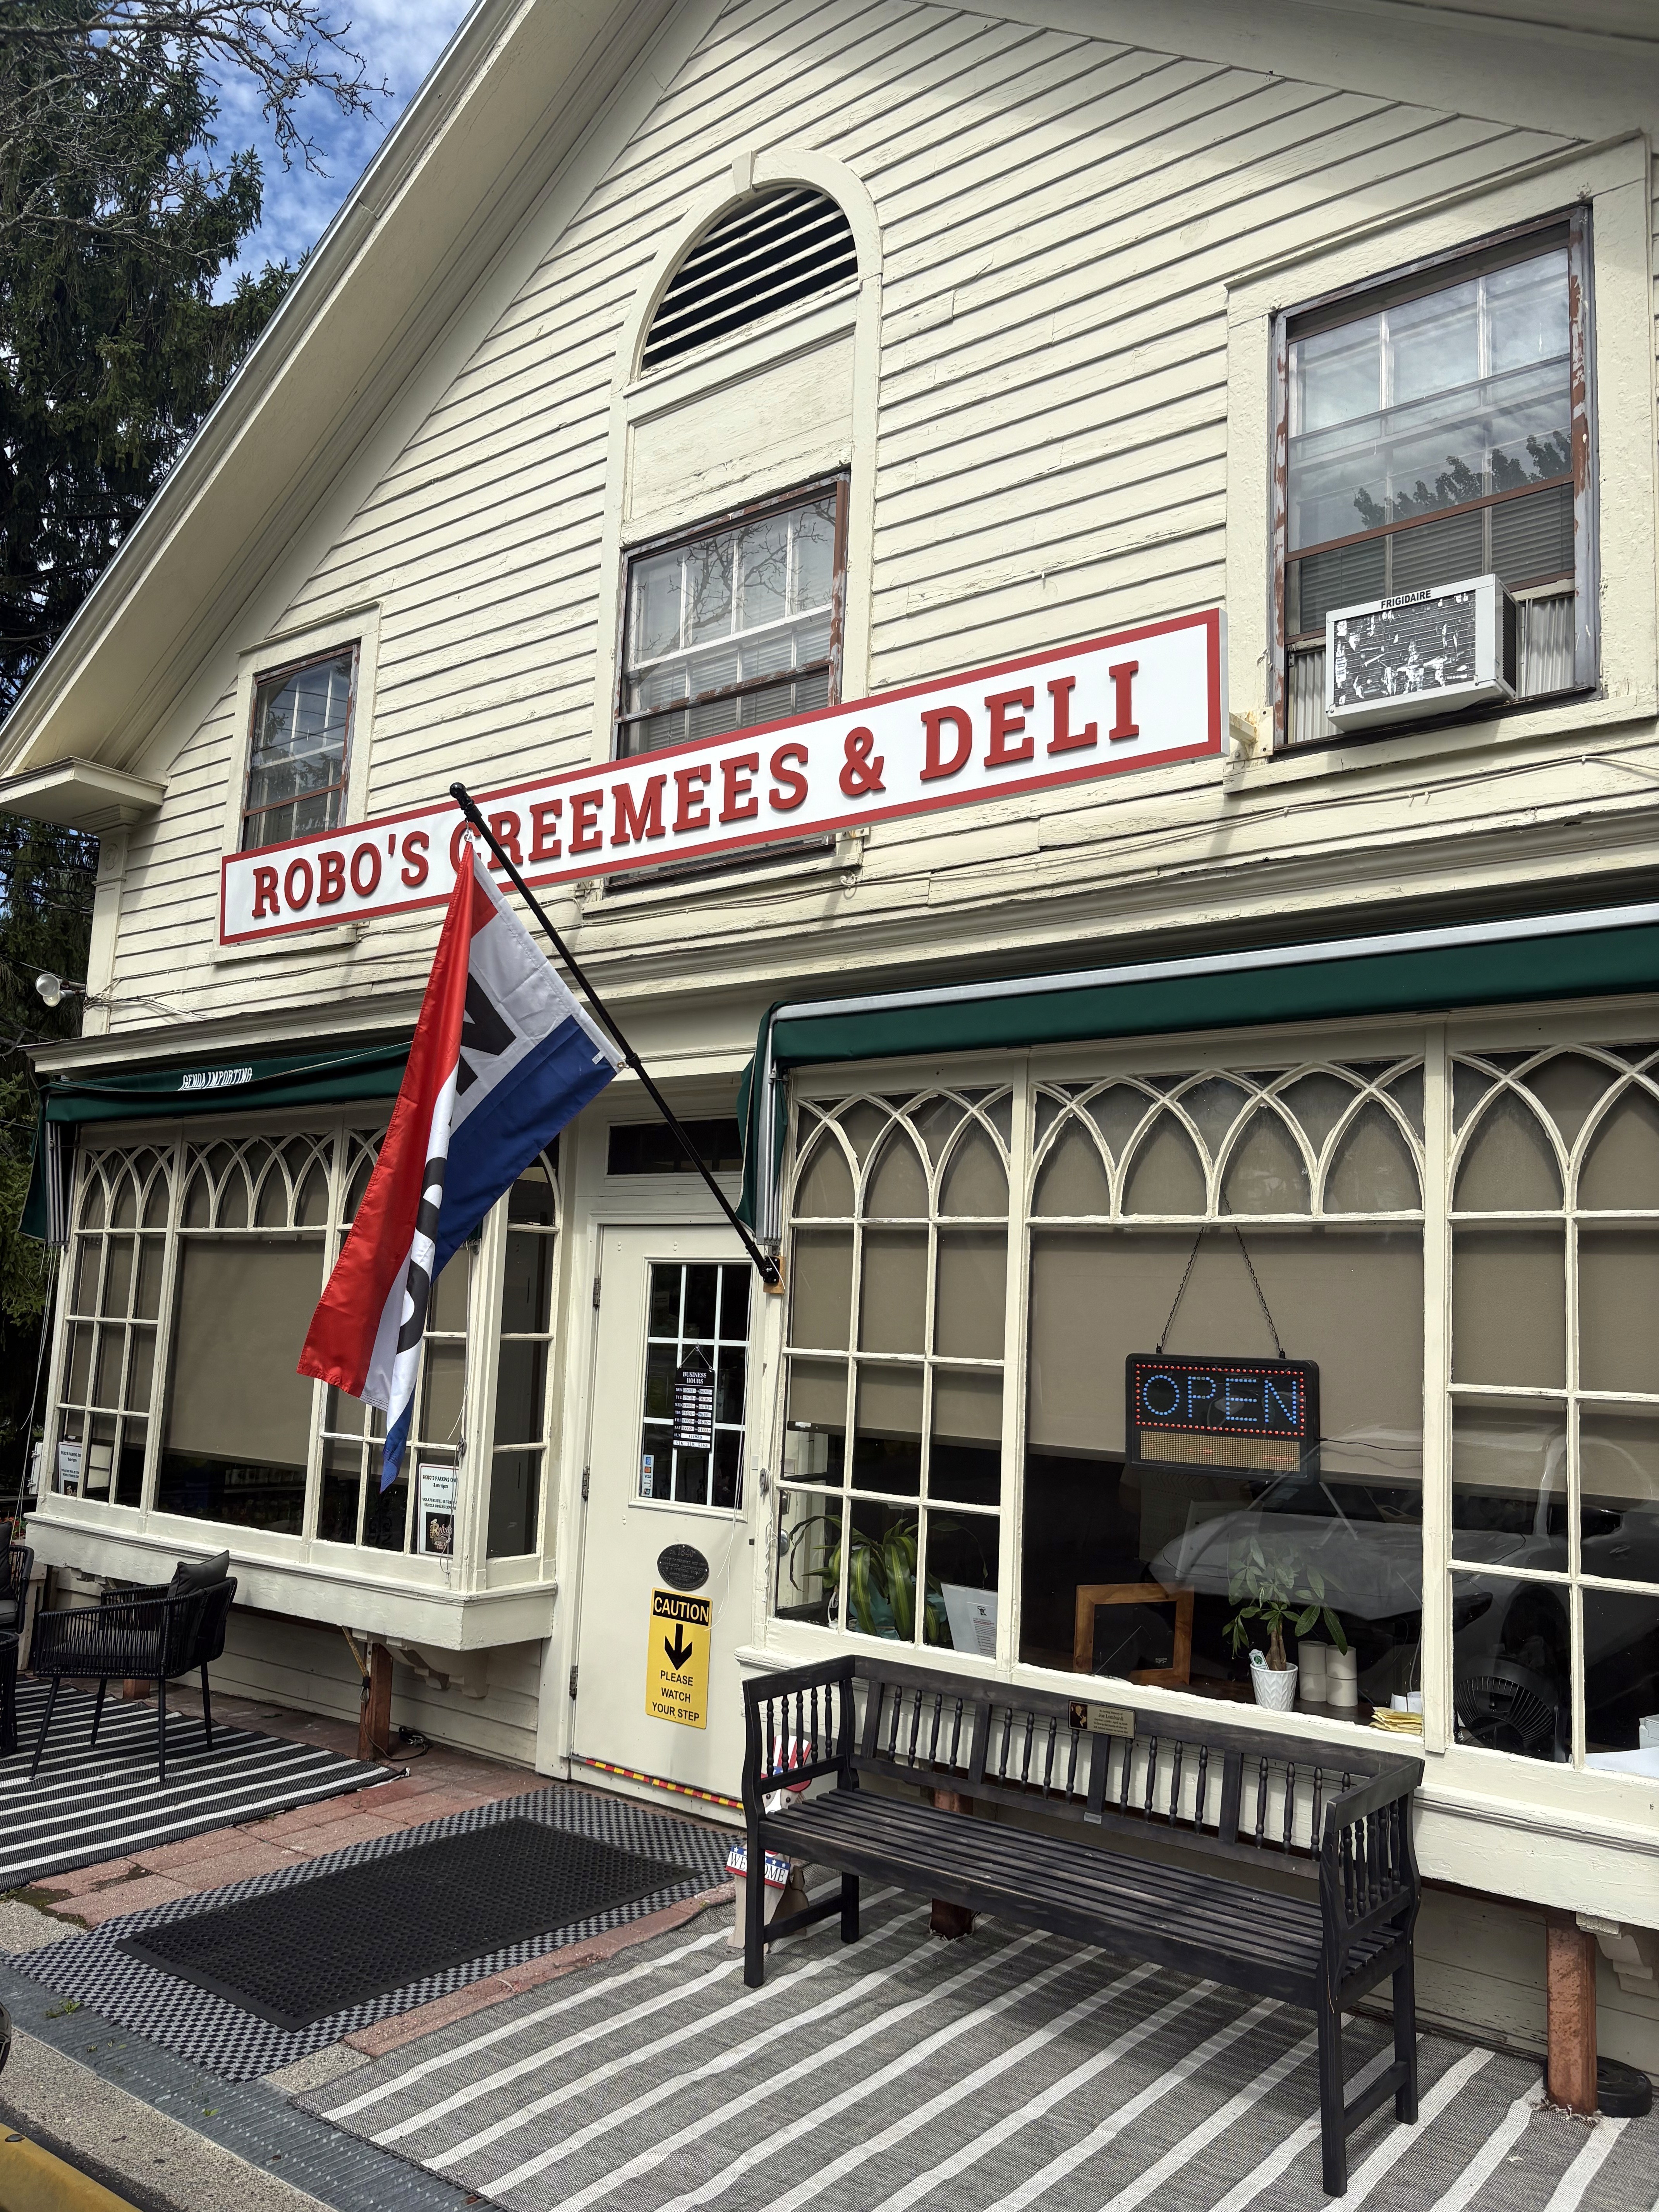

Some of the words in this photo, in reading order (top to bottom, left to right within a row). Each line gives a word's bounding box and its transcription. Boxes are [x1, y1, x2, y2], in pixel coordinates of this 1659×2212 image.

[1381, 589, 1431, 609] FRIGIDAIRE
[252, 831, 429, 917] ROBO'S
[450, 743, 809, 874] CREEMEES
[839, 726, 886, 795] &
[920, 660, 1139, 781] DELI
[178, 1073, 206, 1091] GENOA
[203, 1067, 253, 1088] IMPORTING
[1143, 1374, 1297, 1425] OPEN
[654, 1596, 709, 1623] CAUTION
[660, 1670, 694, 1686] PLEASE
[661, 1687, 691, 1703] WATCH
[652, 1702, 675, 1716] YOUR
[678, 1709, 699, 1722] STEP
